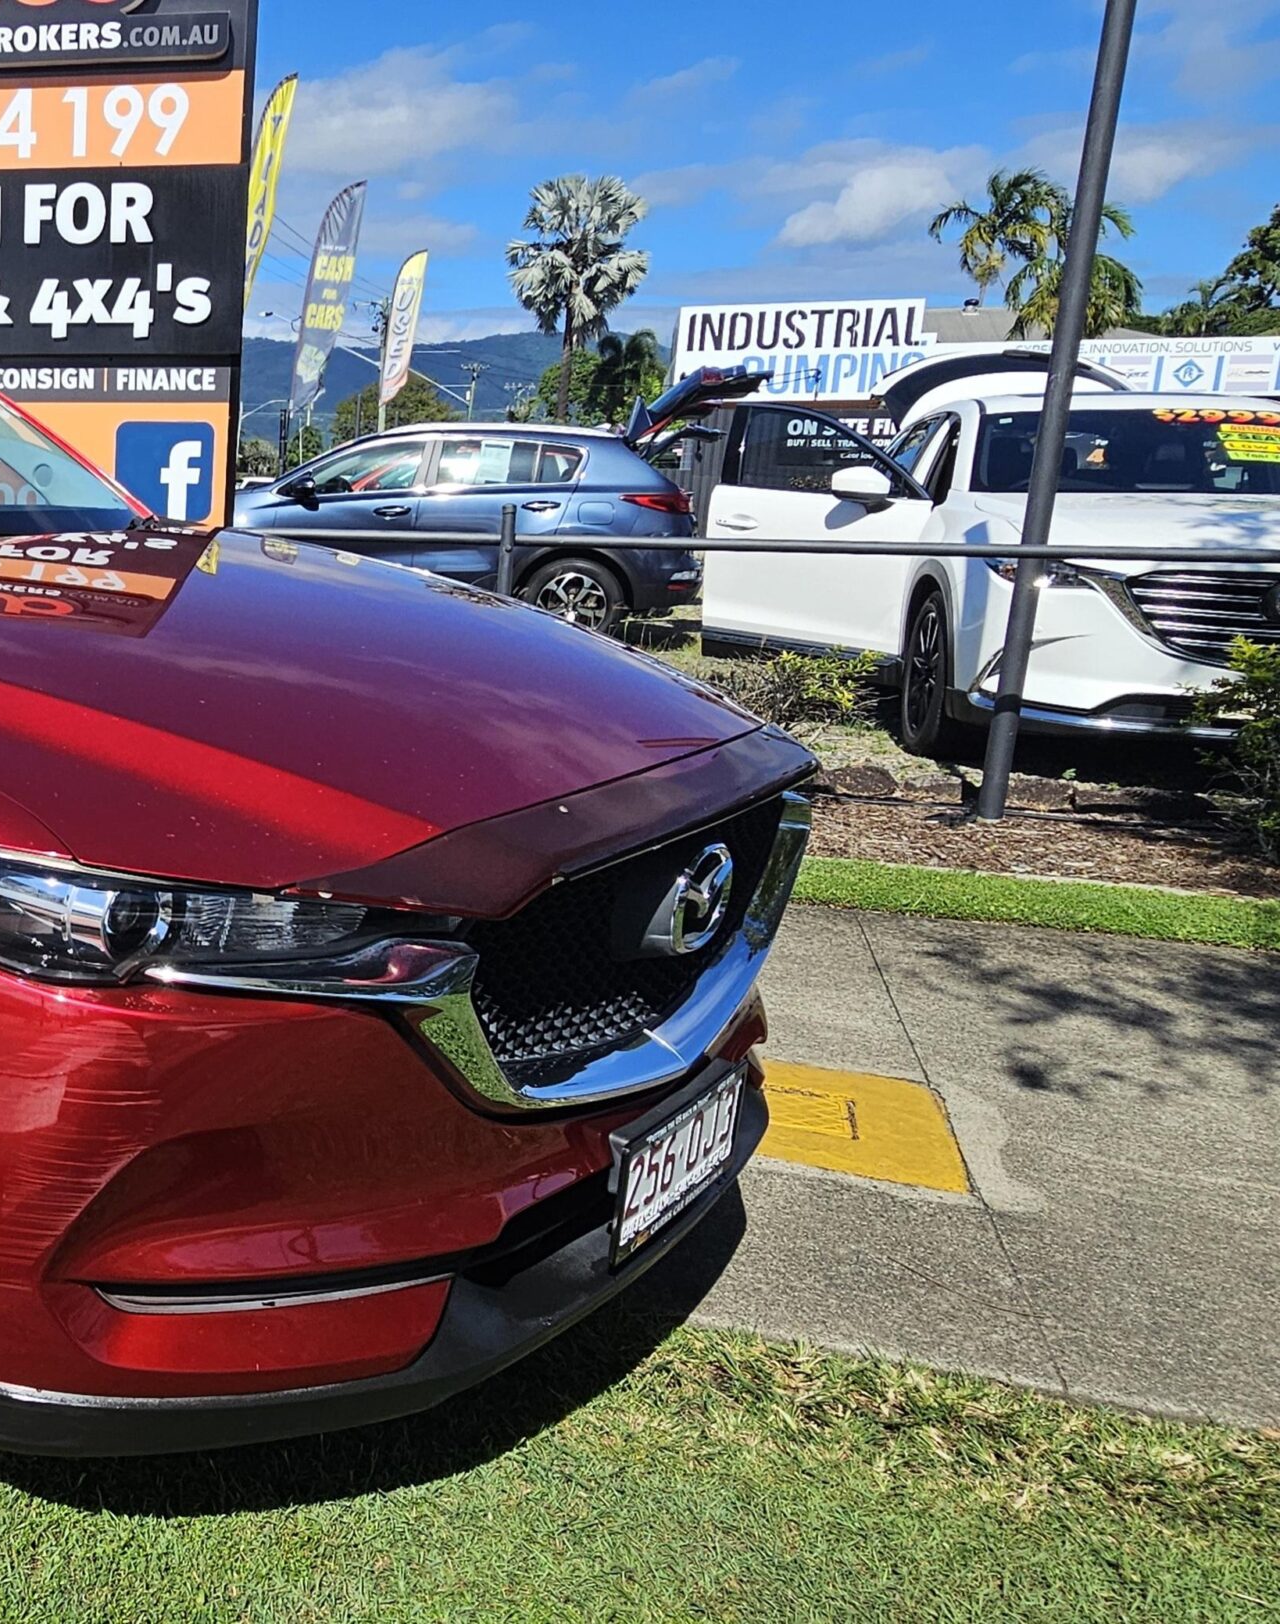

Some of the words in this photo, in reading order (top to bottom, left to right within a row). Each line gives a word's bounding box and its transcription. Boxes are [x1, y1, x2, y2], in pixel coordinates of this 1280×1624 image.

[62, 84, 190, 158] 199
[24, 181, 155, 246] FOR
[383, 288, 416, 382] USED
[1175, 340, 1253, 353] SOLUTIONS
[116, 368, 217, 391] FINANCE
[742, 351, 926, 394] PUMPIN
[787, 419, 818, 435] ON
[822, 418, 869, 435] STE
[1238, 433, 1280, 442] SEA
[787, 439, 806, 448] BUY
[811, 439, 831, 448] SELL
[837, 439, 858, 448] TRA
